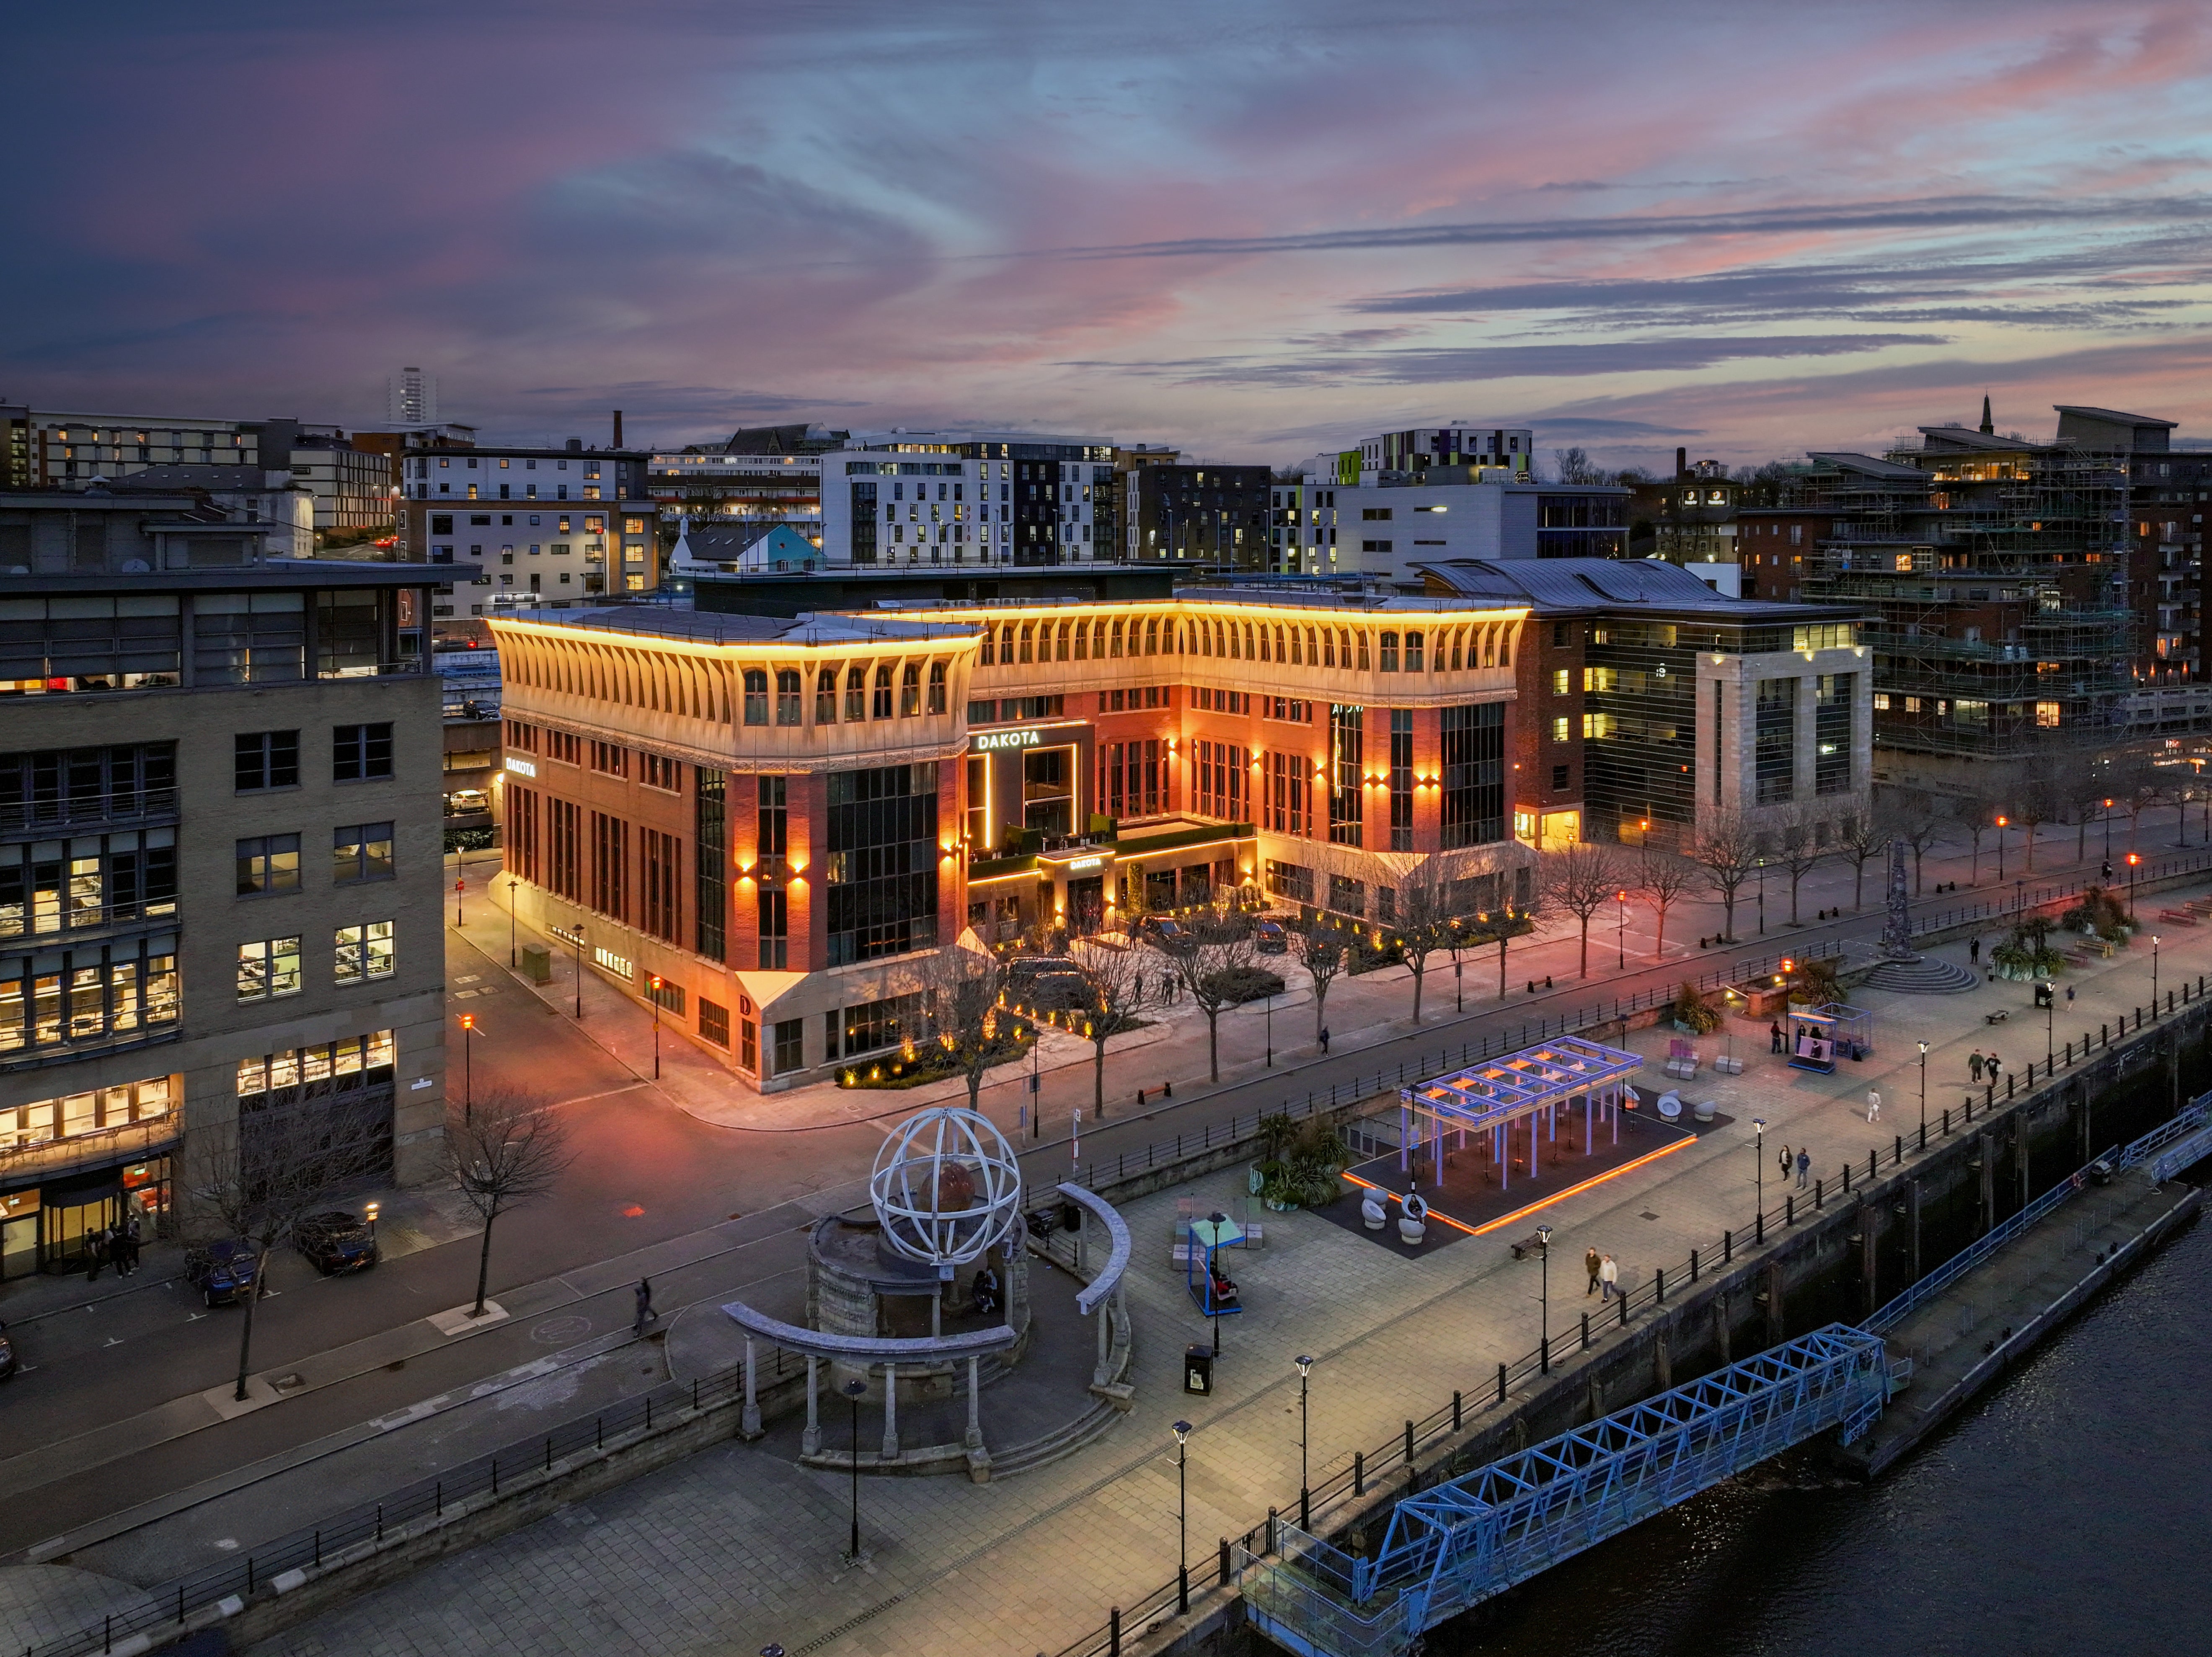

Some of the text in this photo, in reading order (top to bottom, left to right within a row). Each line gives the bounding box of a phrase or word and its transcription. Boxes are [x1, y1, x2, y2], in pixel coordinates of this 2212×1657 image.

[978, 731, 1039, 749] DAKOTA
[506, 757, 536, 778] DAKOTA
[1070, 857, 1101, 870] DAKOTA
[740, 994, 751, 1016] D
